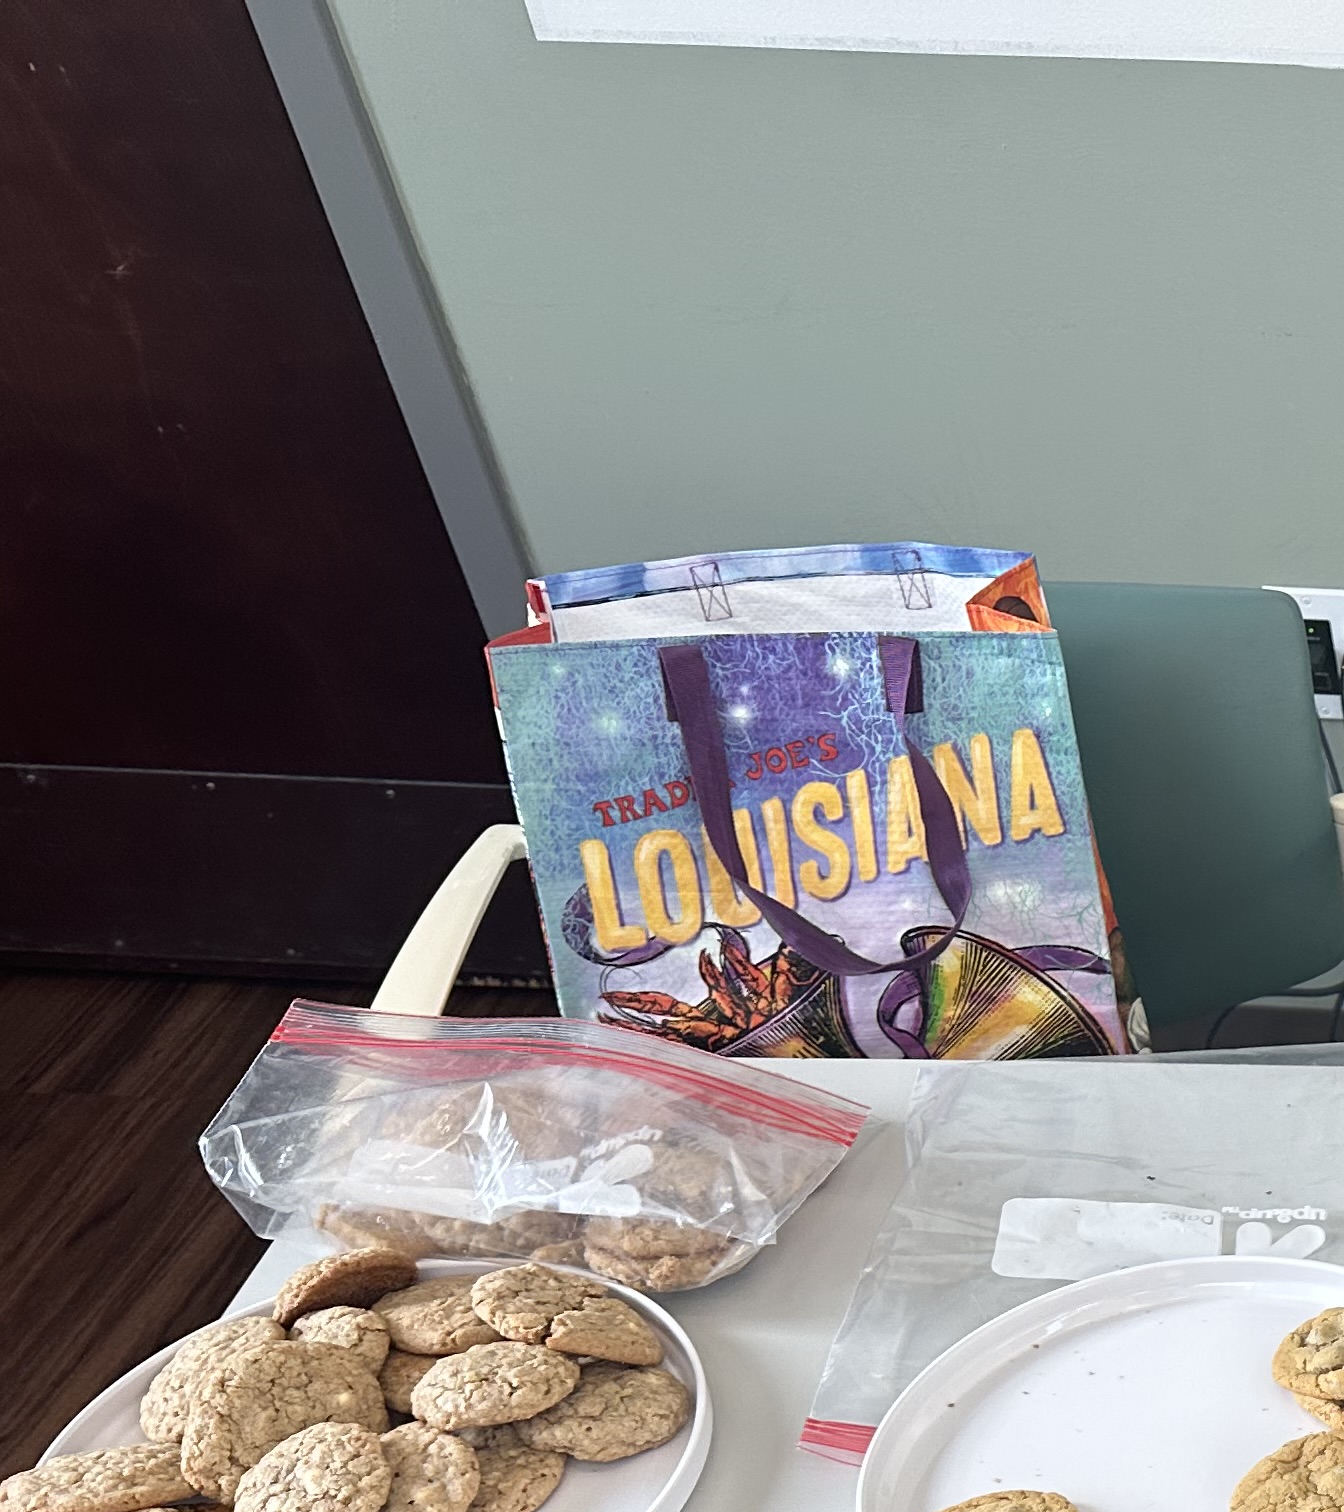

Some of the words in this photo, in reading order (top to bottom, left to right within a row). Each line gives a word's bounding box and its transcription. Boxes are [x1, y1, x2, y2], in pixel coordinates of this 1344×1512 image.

[580, 728, 1065, 951] LOUISIANA
[593, 775, 735, 827] TRAD
[745, 732, 839, 781] JOE'S
